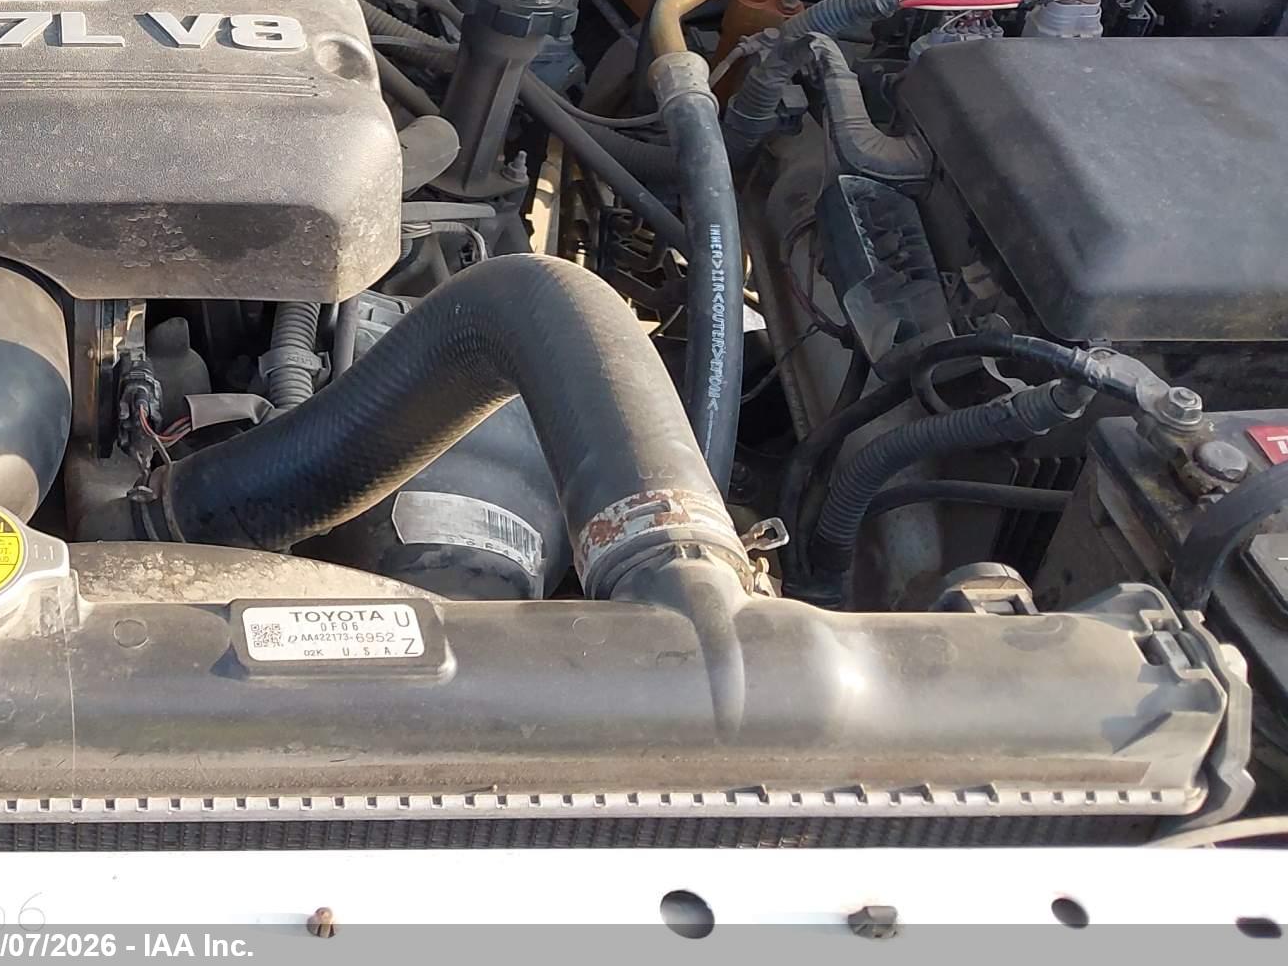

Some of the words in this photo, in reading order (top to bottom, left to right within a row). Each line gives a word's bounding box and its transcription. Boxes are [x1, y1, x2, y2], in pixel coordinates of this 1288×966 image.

[145, 12, 307, 52] V8
[289, 610, 385, 623] TOYOTA
[394, 611, 411, 628] U
[401, 637, 419, 655] Z
